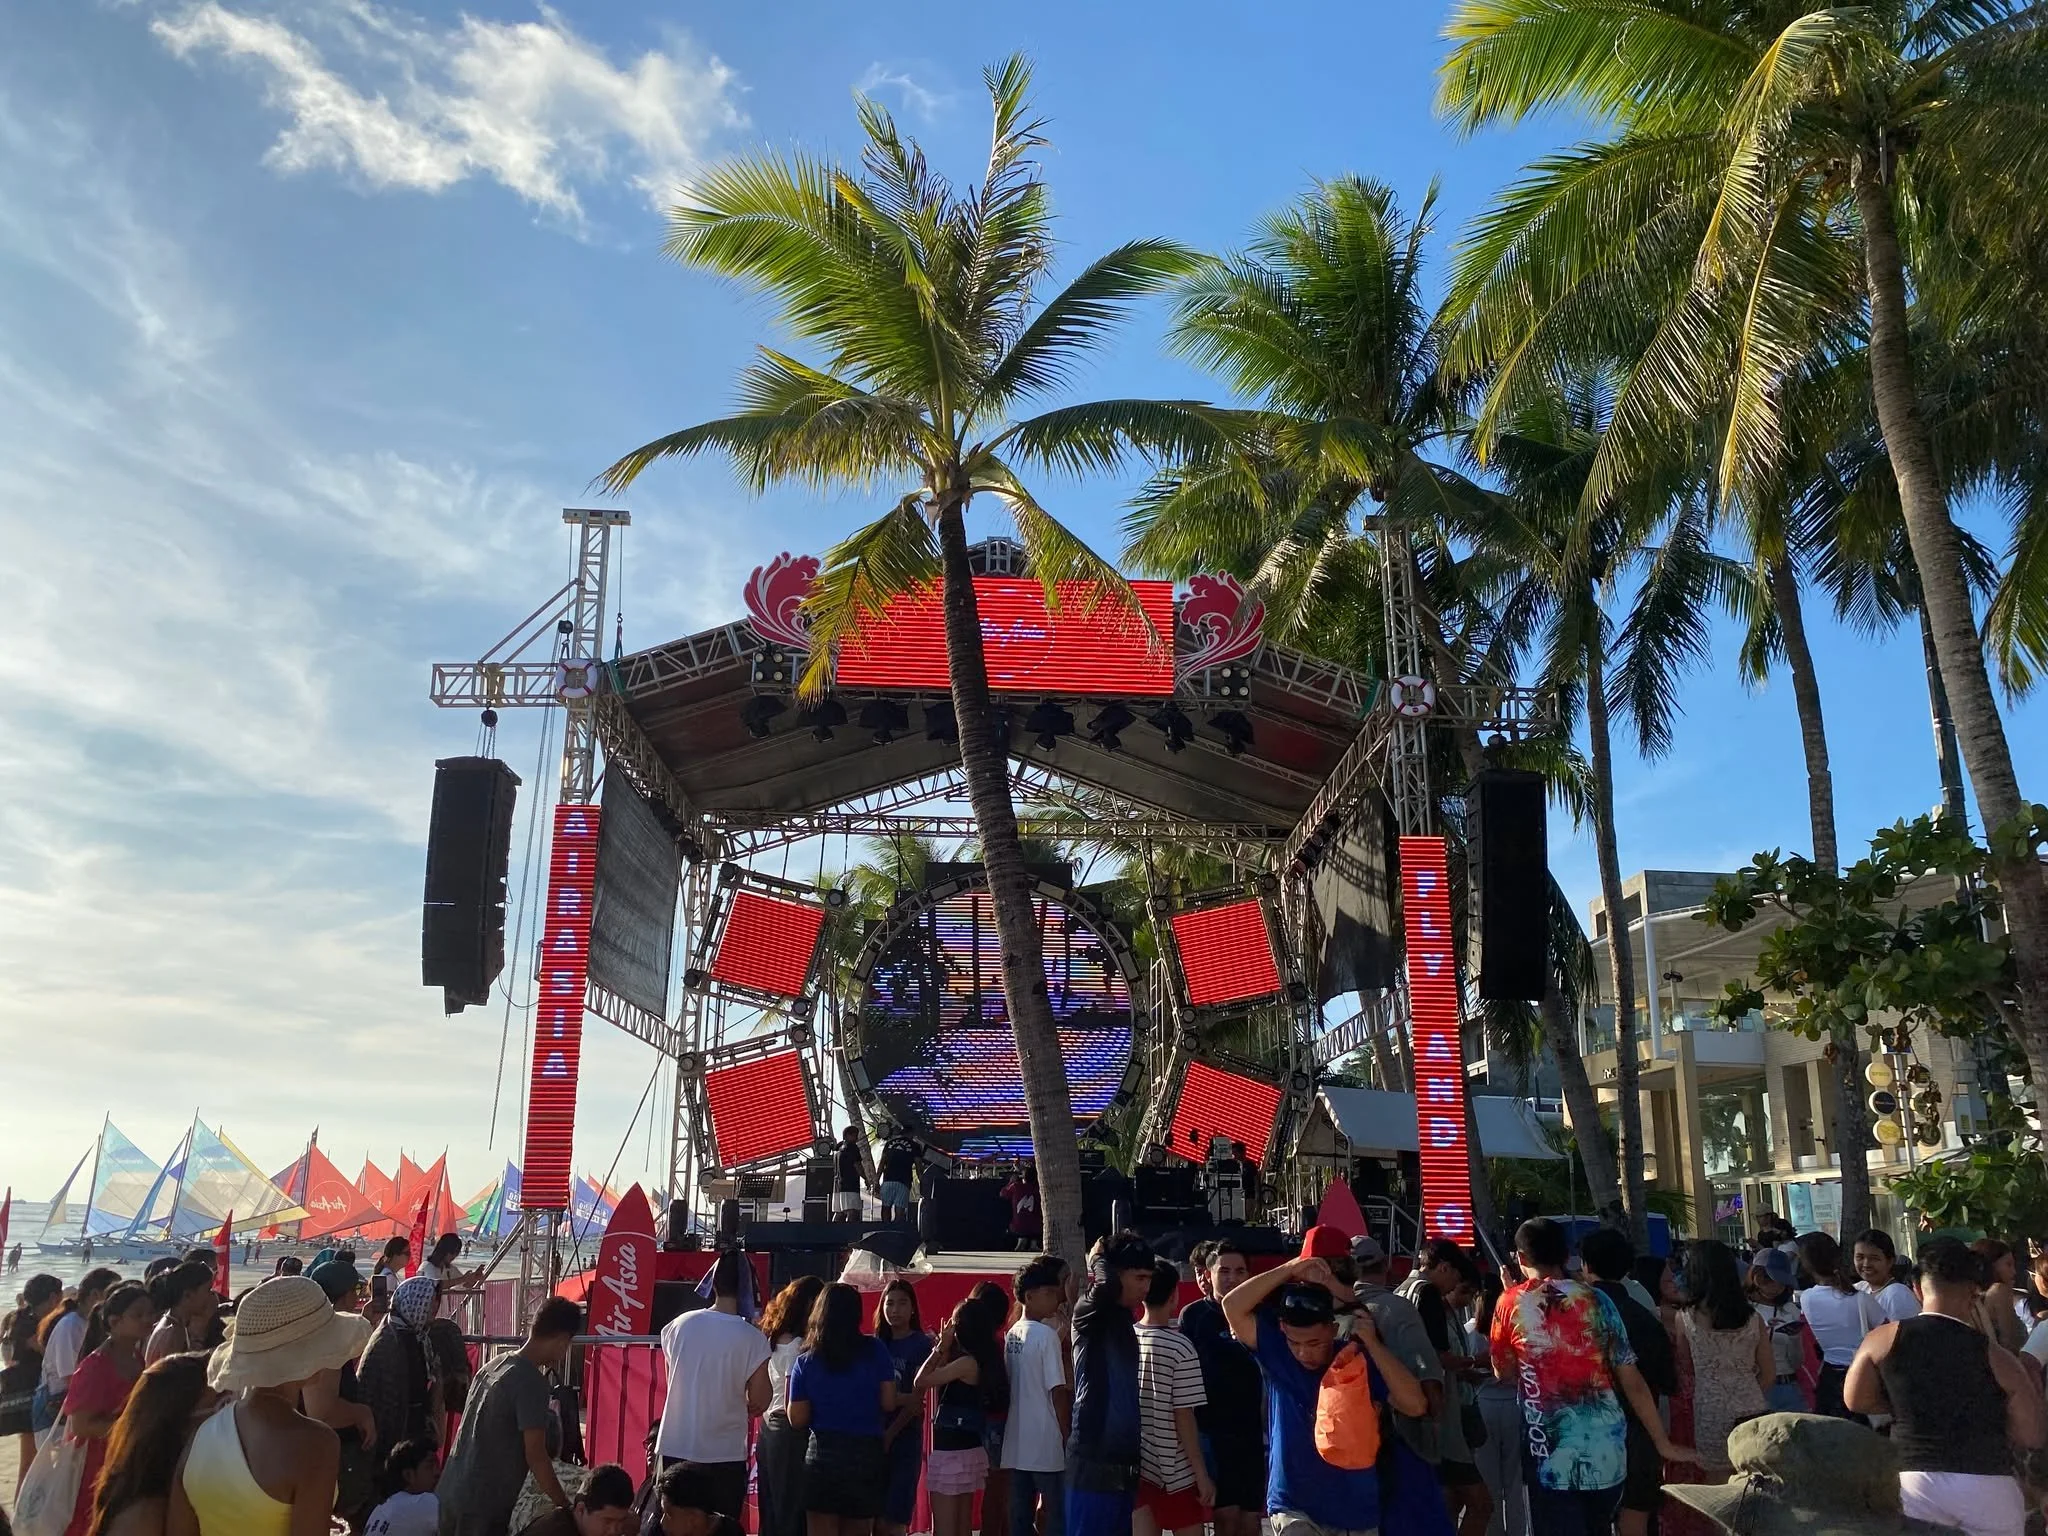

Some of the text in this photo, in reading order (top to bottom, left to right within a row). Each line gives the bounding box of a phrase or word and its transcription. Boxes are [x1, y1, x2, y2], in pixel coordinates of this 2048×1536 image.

[542, 811, 588, 1077] AIRASIA
[1416, 871, 1445, 977] FLY
[1426, 1033, 1458, 1148] AND
[1519, 1358, 1549, 1459] BORACAY
